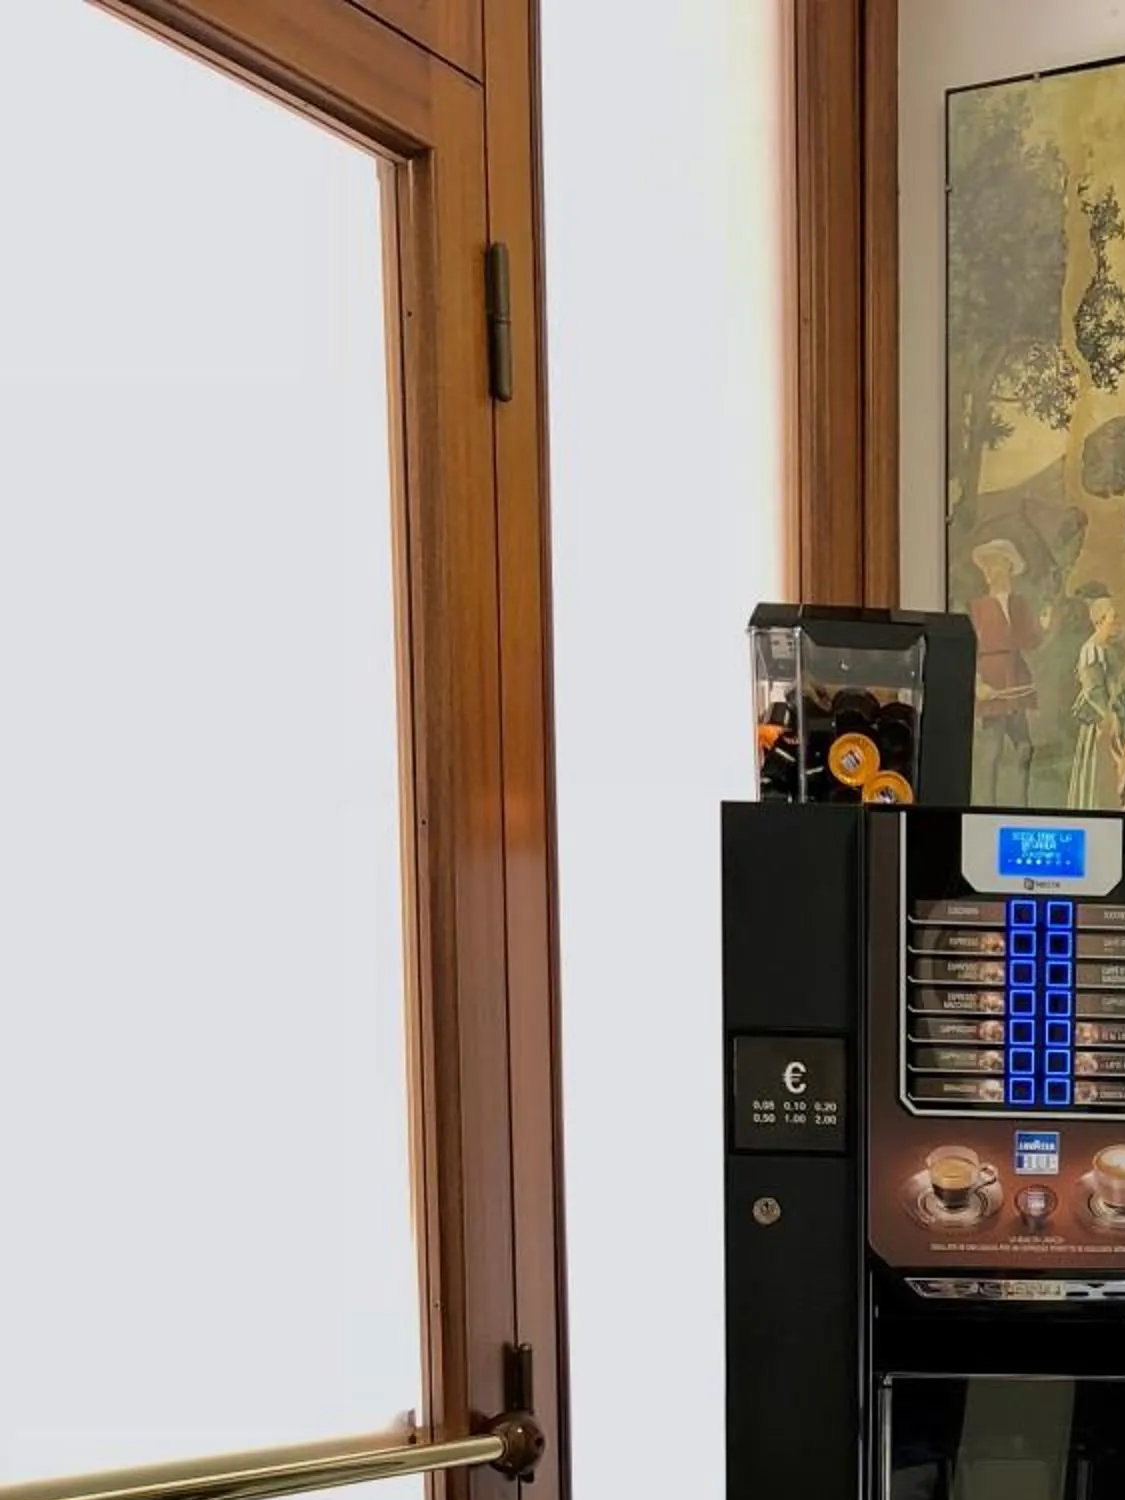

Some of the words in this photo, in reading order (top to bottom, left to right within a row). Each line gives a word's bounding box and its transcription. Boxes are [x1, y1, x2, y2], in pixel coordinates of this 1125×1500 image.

[783, 1101, 807, 1111] 0.10
[784, 1114, 807, 1123] 1.00
[815, 1115, 837, 1125] 2.00
